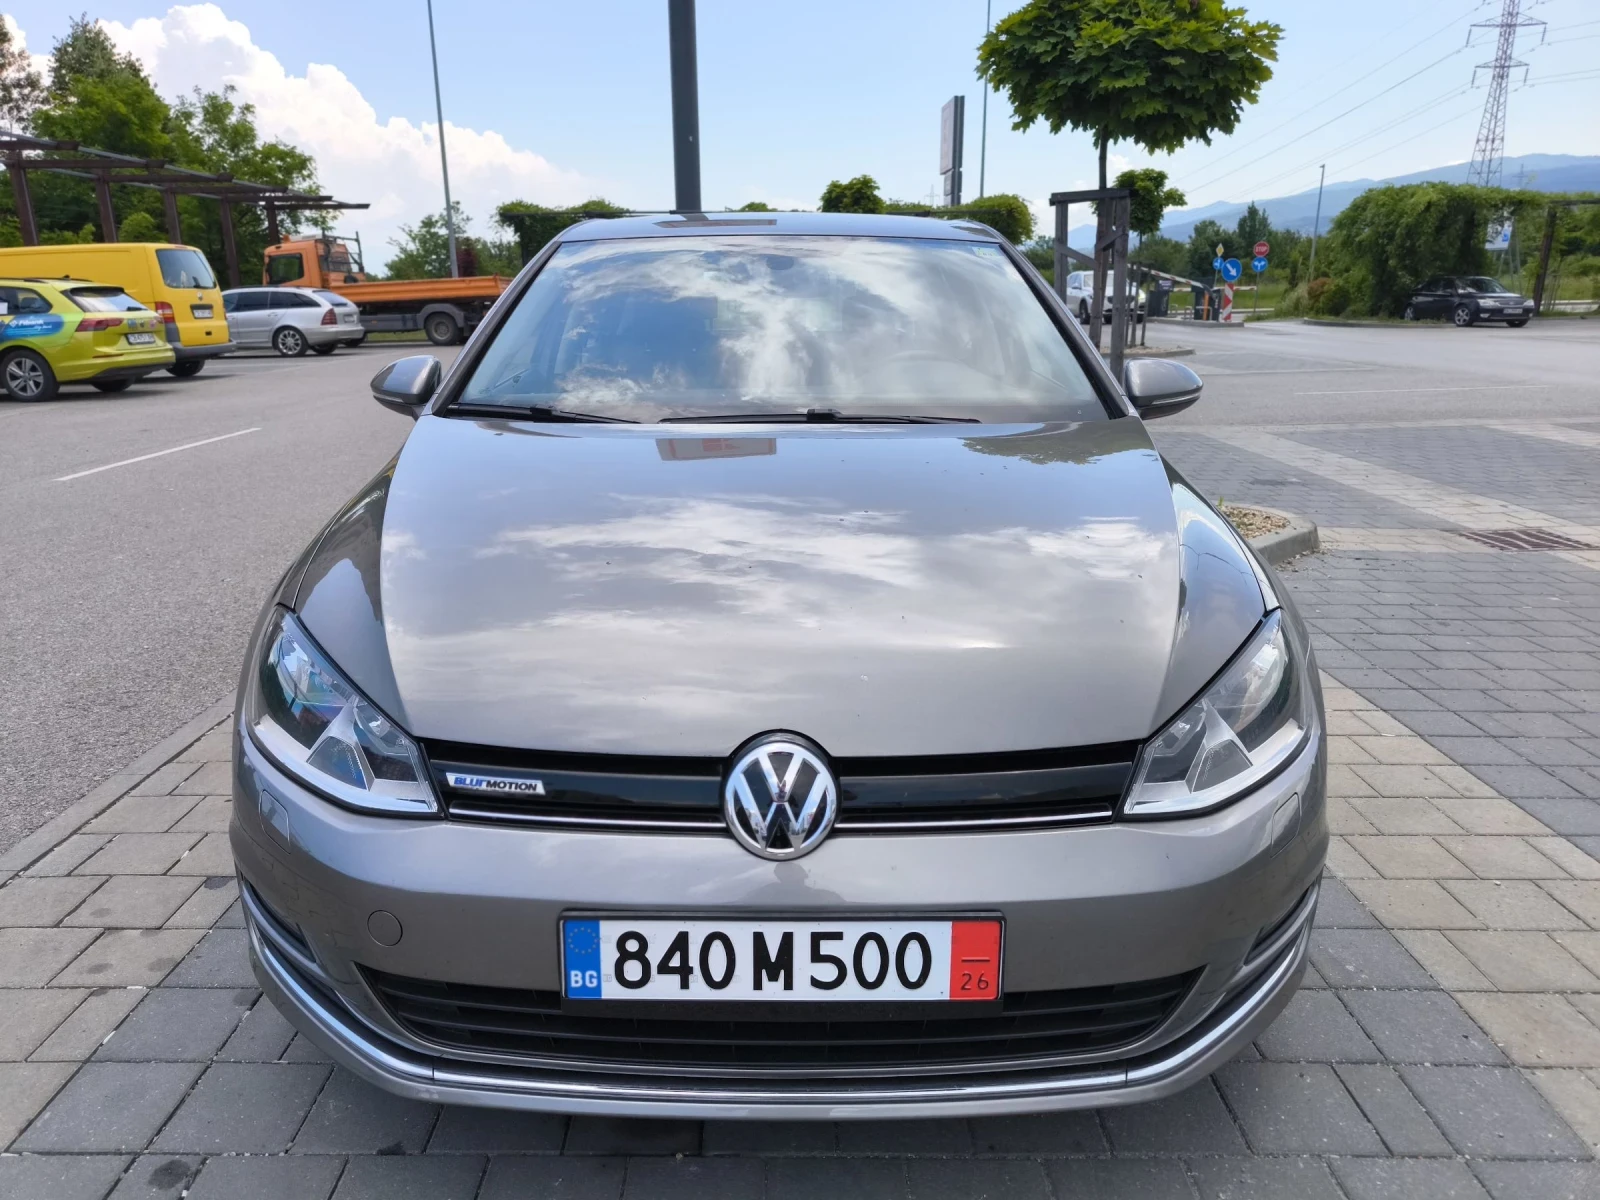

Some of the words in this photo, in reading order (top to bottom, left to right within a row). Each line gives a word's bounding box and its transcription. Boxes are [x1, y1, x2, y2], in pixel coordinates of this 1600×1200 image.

[614, 930, 736, 990] 840
[753, 931, 794, 990] M
[810, 931, 932, 990] 500
[570, 970, 598, 988] BG
[960, 972, 989, 991] 26
